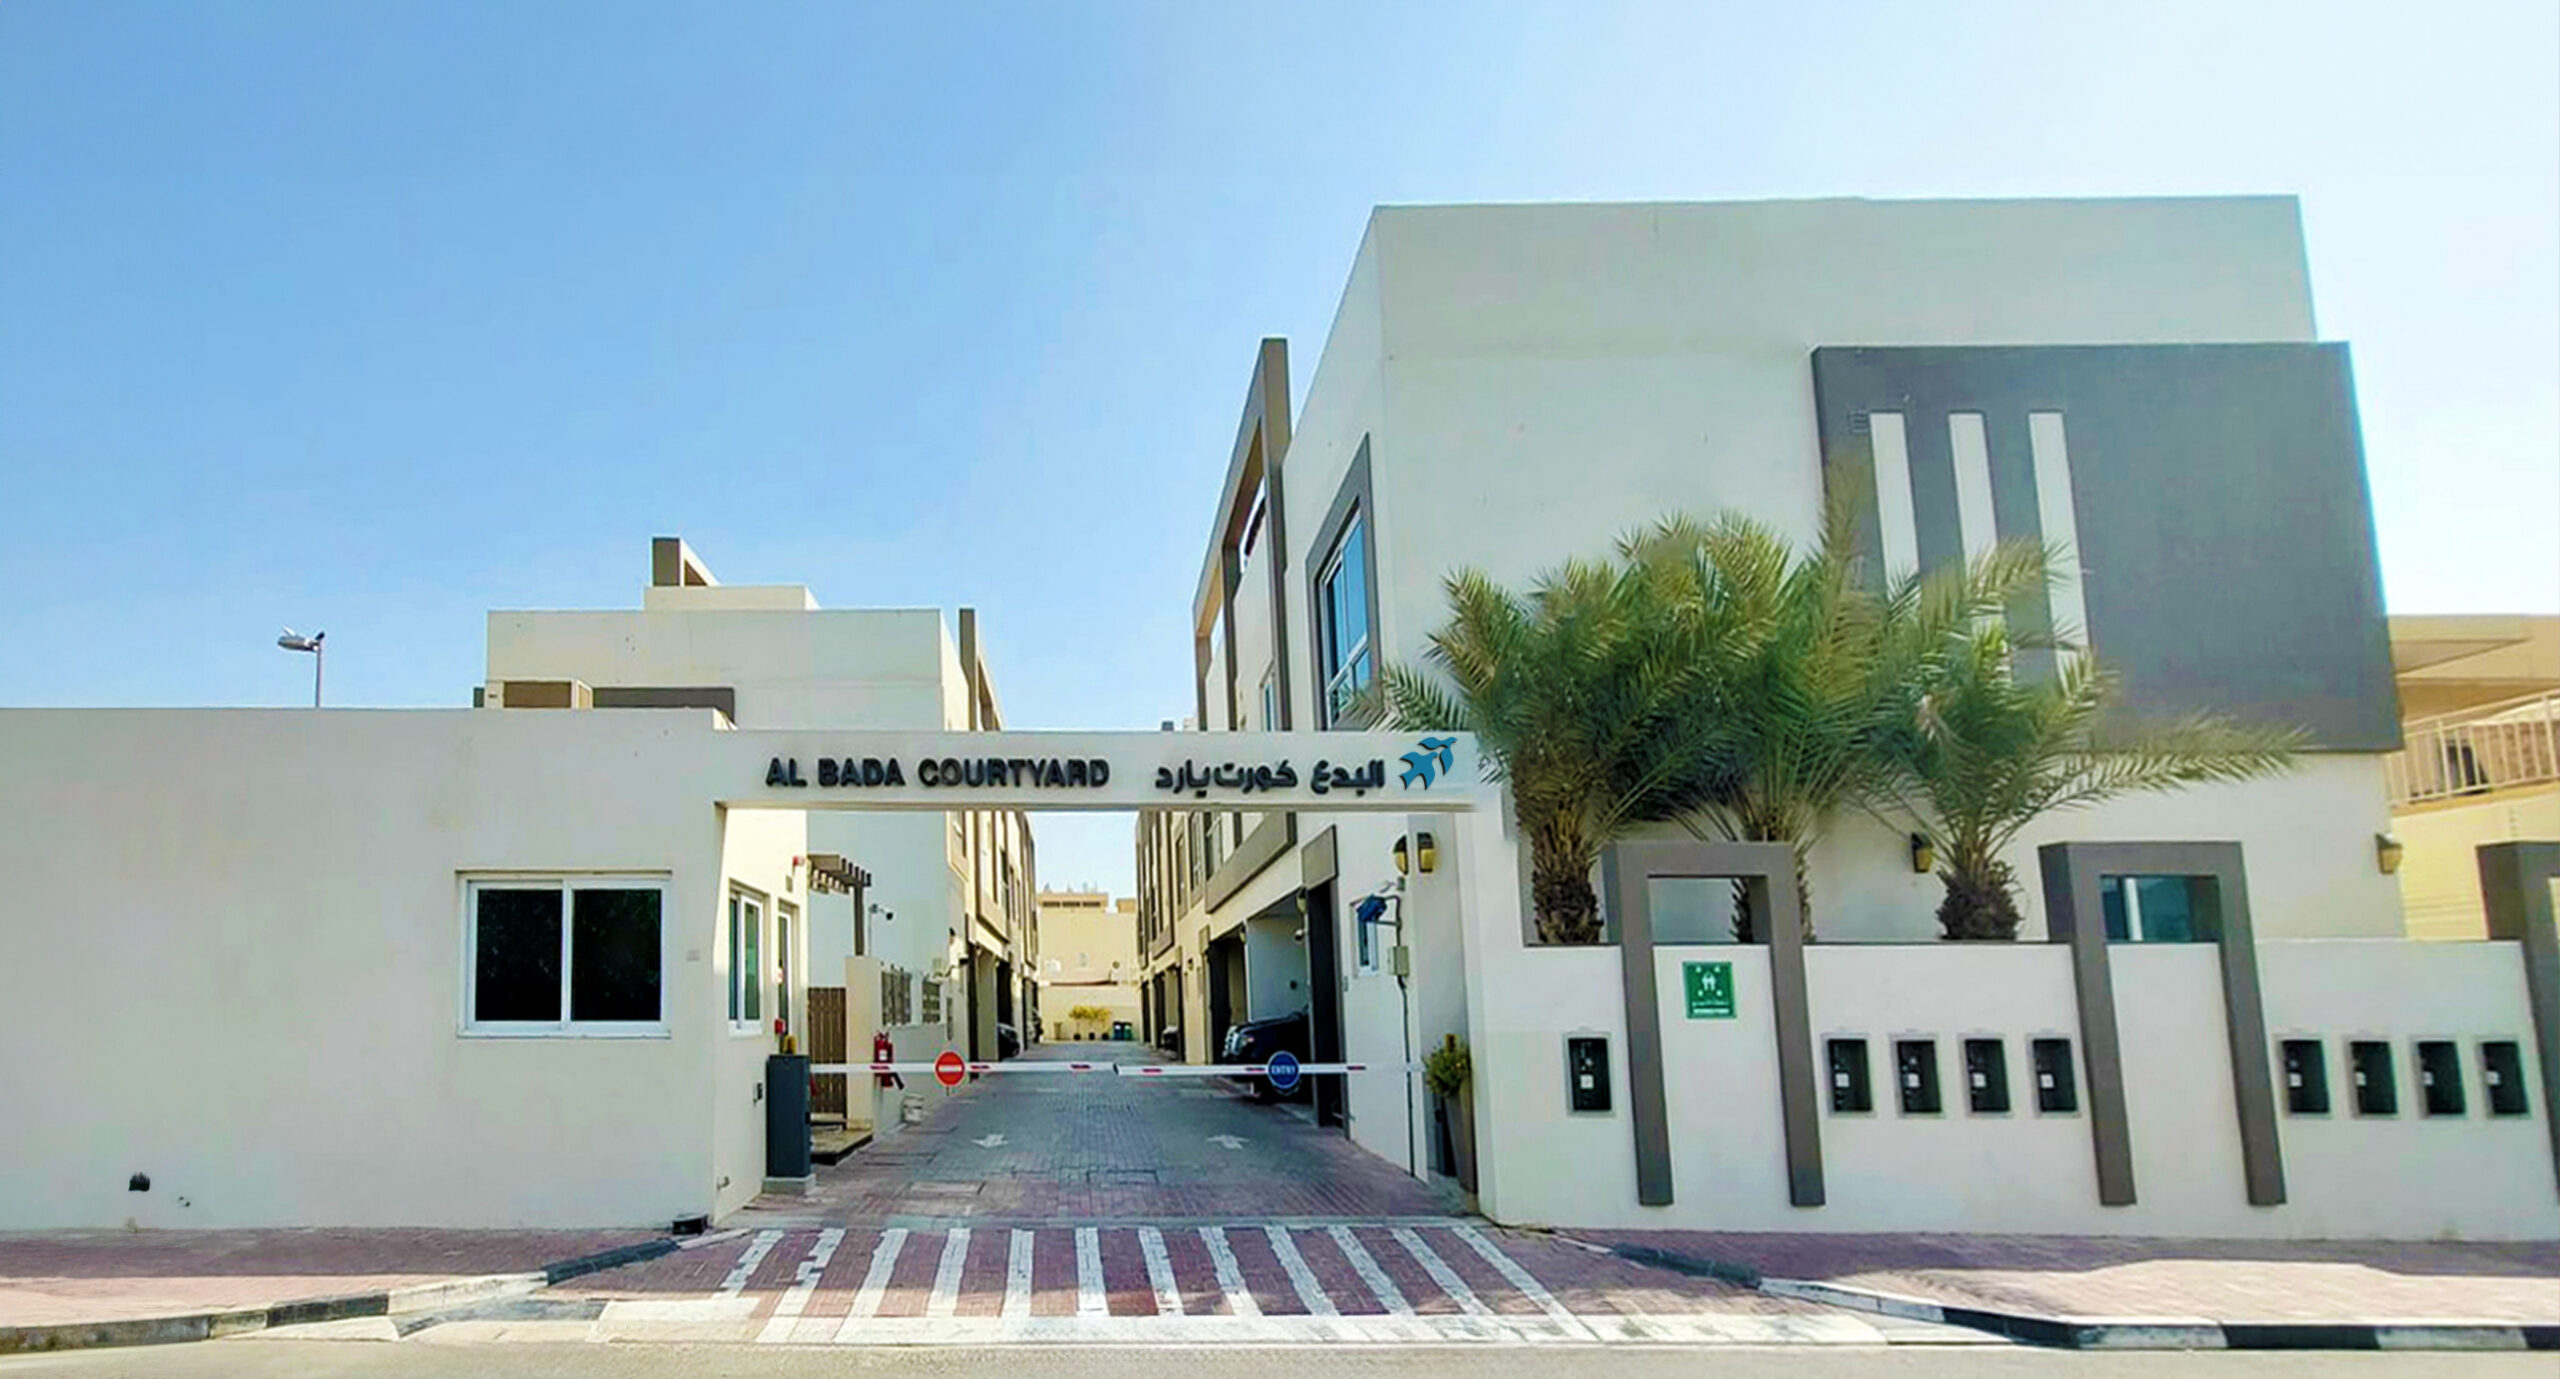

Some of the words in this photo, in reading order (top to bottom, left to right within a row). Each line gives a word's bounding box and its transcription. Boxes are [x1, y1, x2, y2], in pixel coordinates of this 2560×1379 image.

[765, 757, 808, 787] AL
[817, 757, 906, 787] BADA
[918, 757, 1110, 787] COURTYARD
[1310, 759, 1385, 795] البدع
